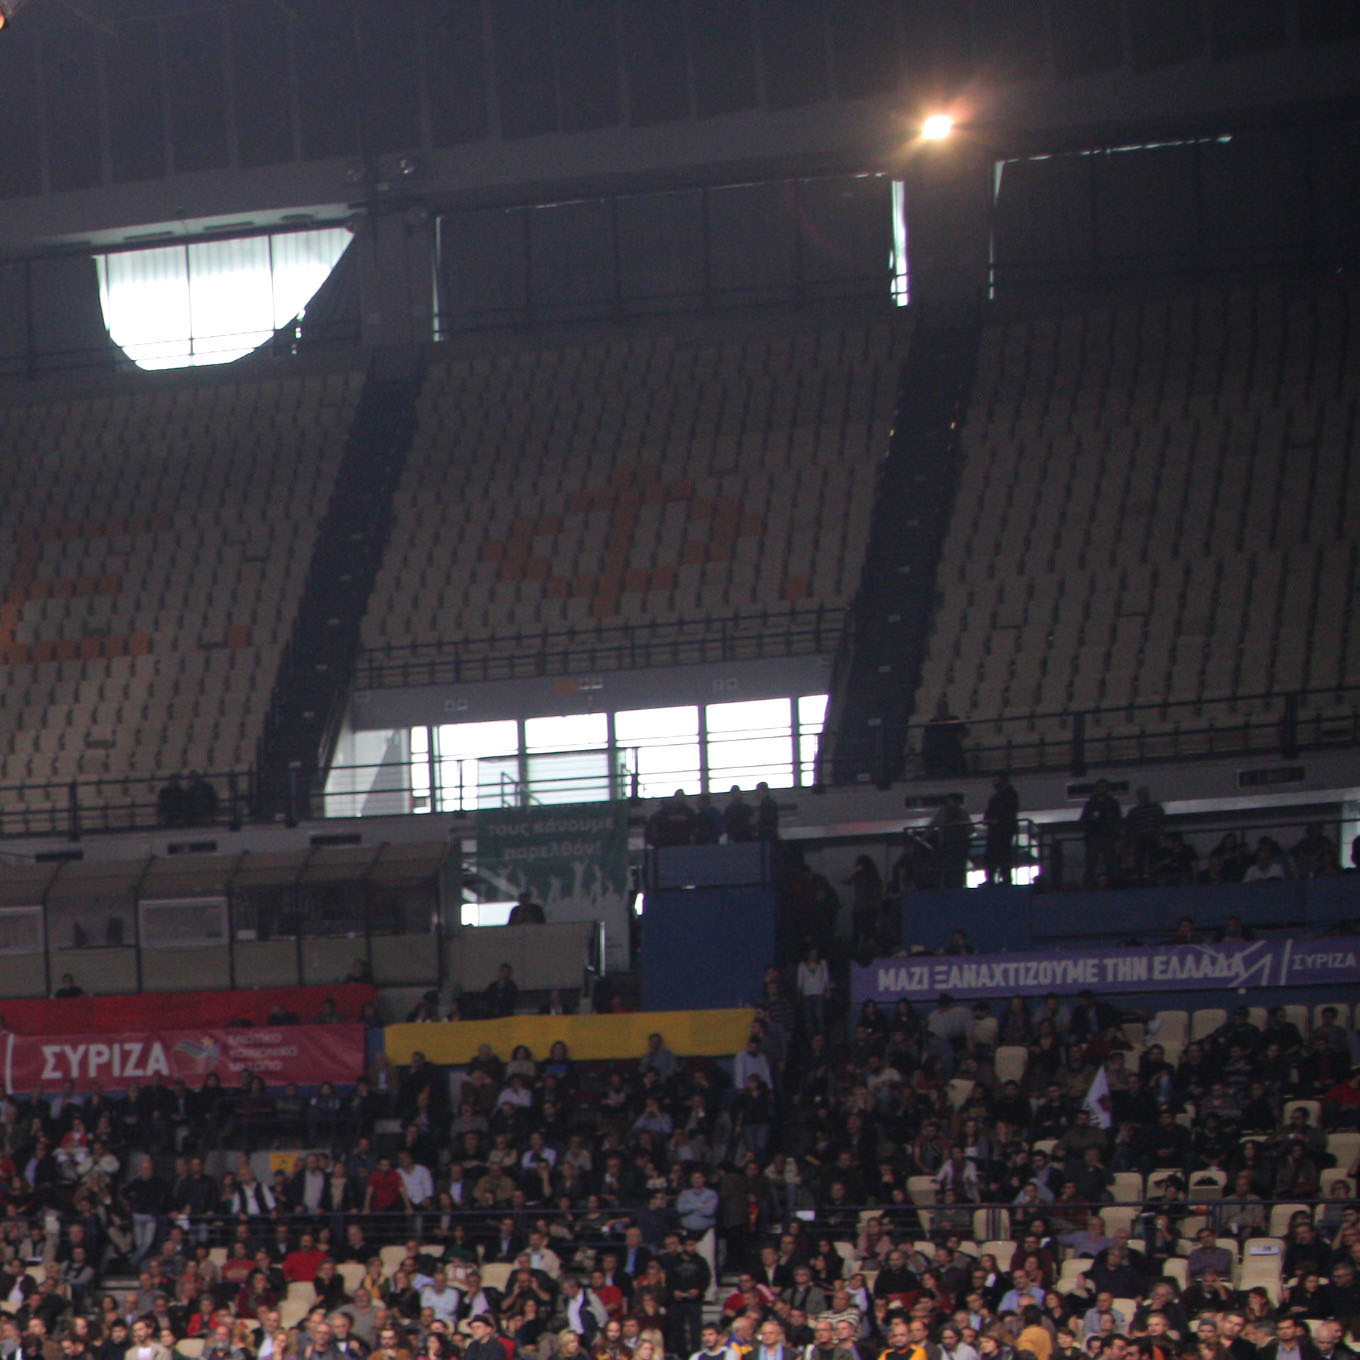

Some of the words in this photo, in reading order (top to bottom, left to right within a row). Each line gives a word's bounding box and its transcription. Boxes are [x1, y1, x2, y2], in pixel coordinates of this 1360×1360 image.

[877, 966, 929, 993] ΜΑΖΙ
[933, 957, 1099, 991] ΞΑΝΑΧΤΙΖΟΥΜΕ
[1103, 956, 1148, 983] ΤΗΝ
[1152, 951, 1246, 981] ΕΛΛΑΔΑ
[1292, 952, 1357, 972] ΣΥΡΙΖΑ
[40, 1041, 171, 1080] ΣΥΡΙΖΑ
